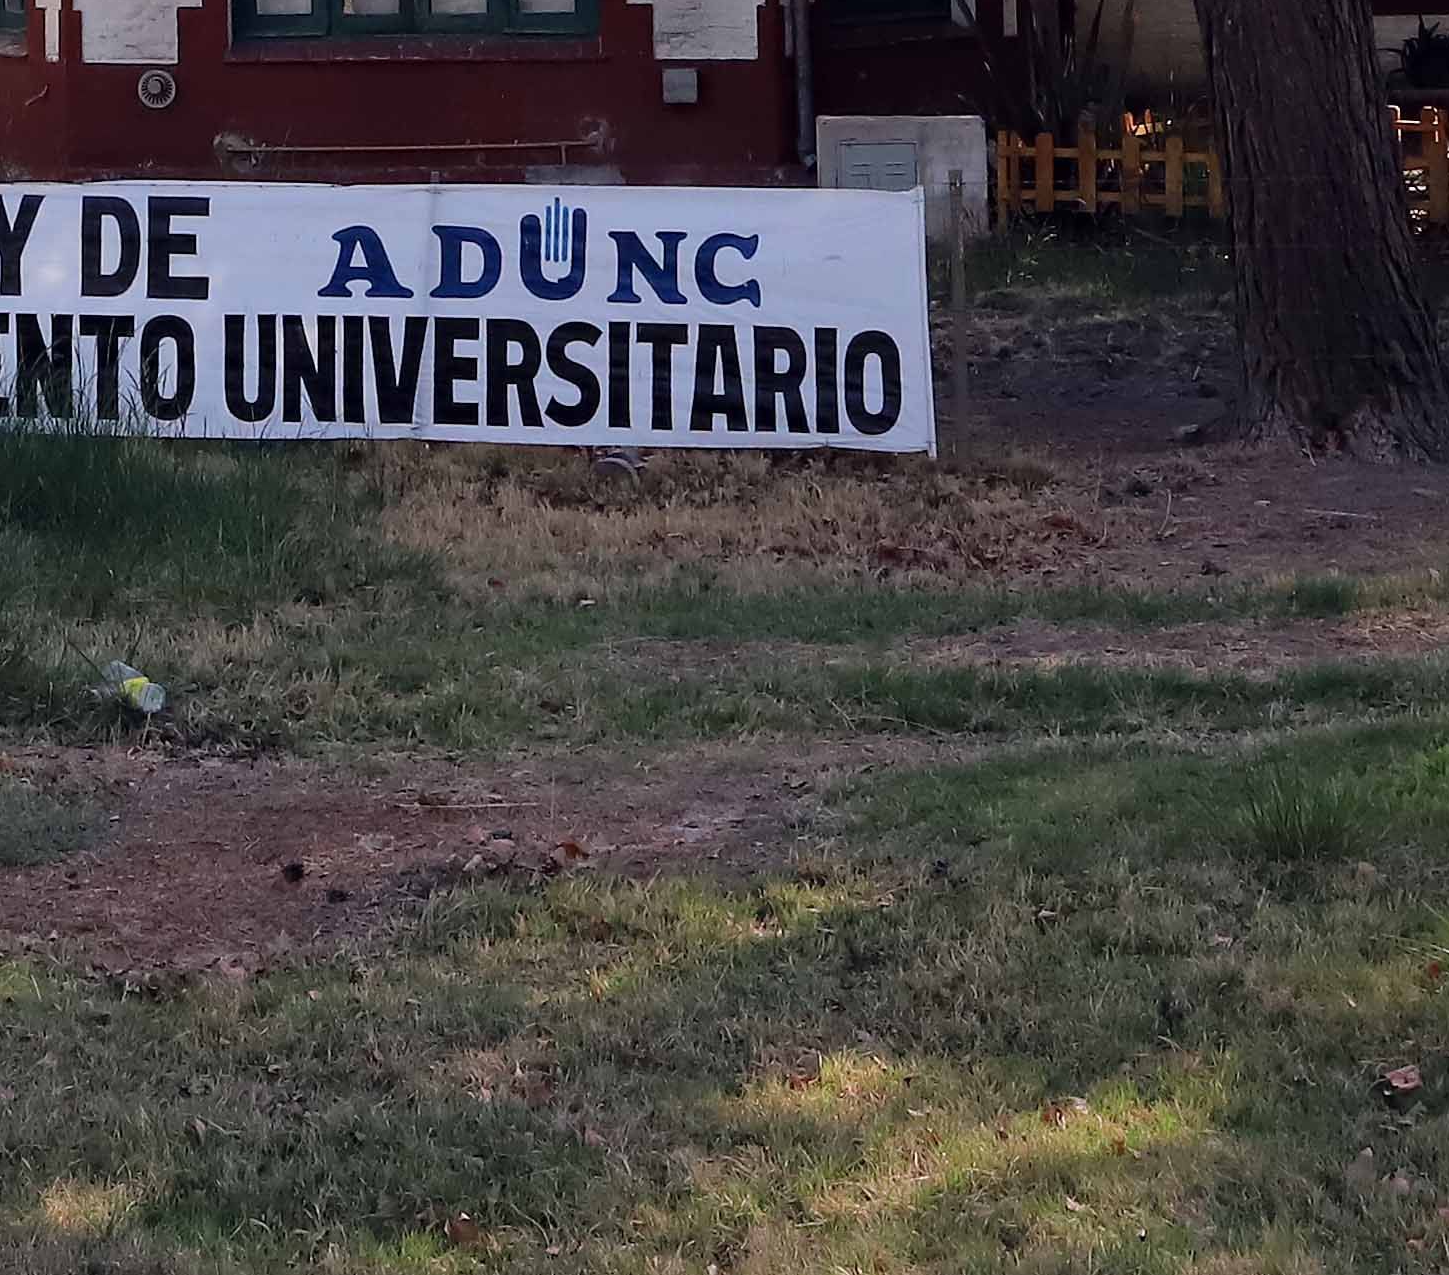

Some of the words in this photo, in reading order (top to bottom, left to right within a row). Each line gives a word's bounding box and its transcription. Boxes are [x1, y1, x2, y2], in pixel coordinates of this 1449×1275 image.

[80, 194, 211, 300] DE
[317, 197, 761, 308] ADUNC
[224, 314, 903, 436] UNIVERSITARIO
